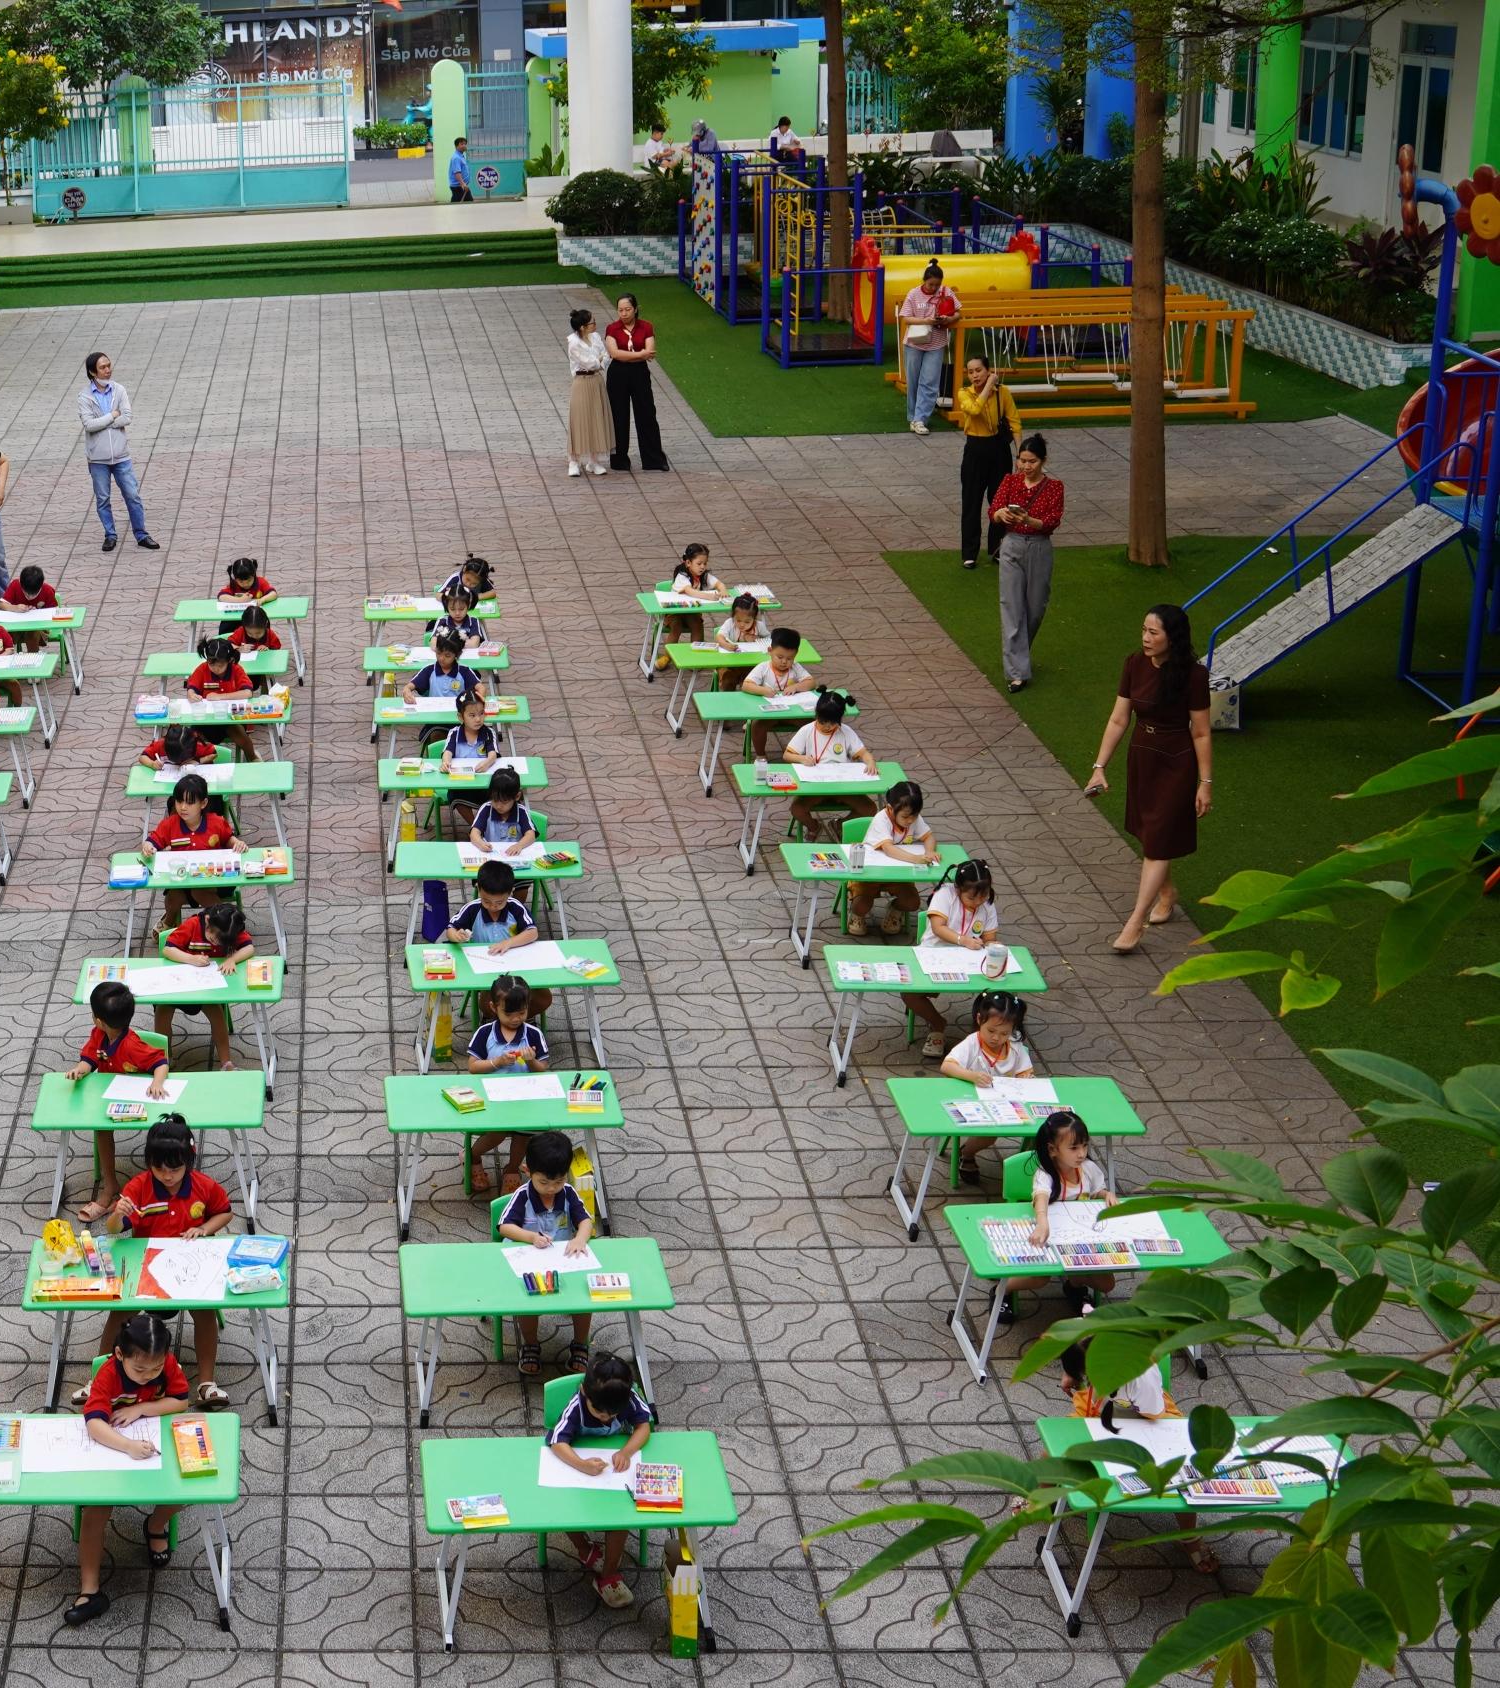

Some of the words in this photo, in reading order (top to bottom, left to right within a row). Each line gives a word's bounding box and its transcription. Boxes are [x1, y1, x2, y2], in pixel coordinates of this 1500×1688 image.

[213, 15, 371, 43] HLANDS
[414, 45, 439, 59] Mở
[441, 44, 471, 57] Cửa
